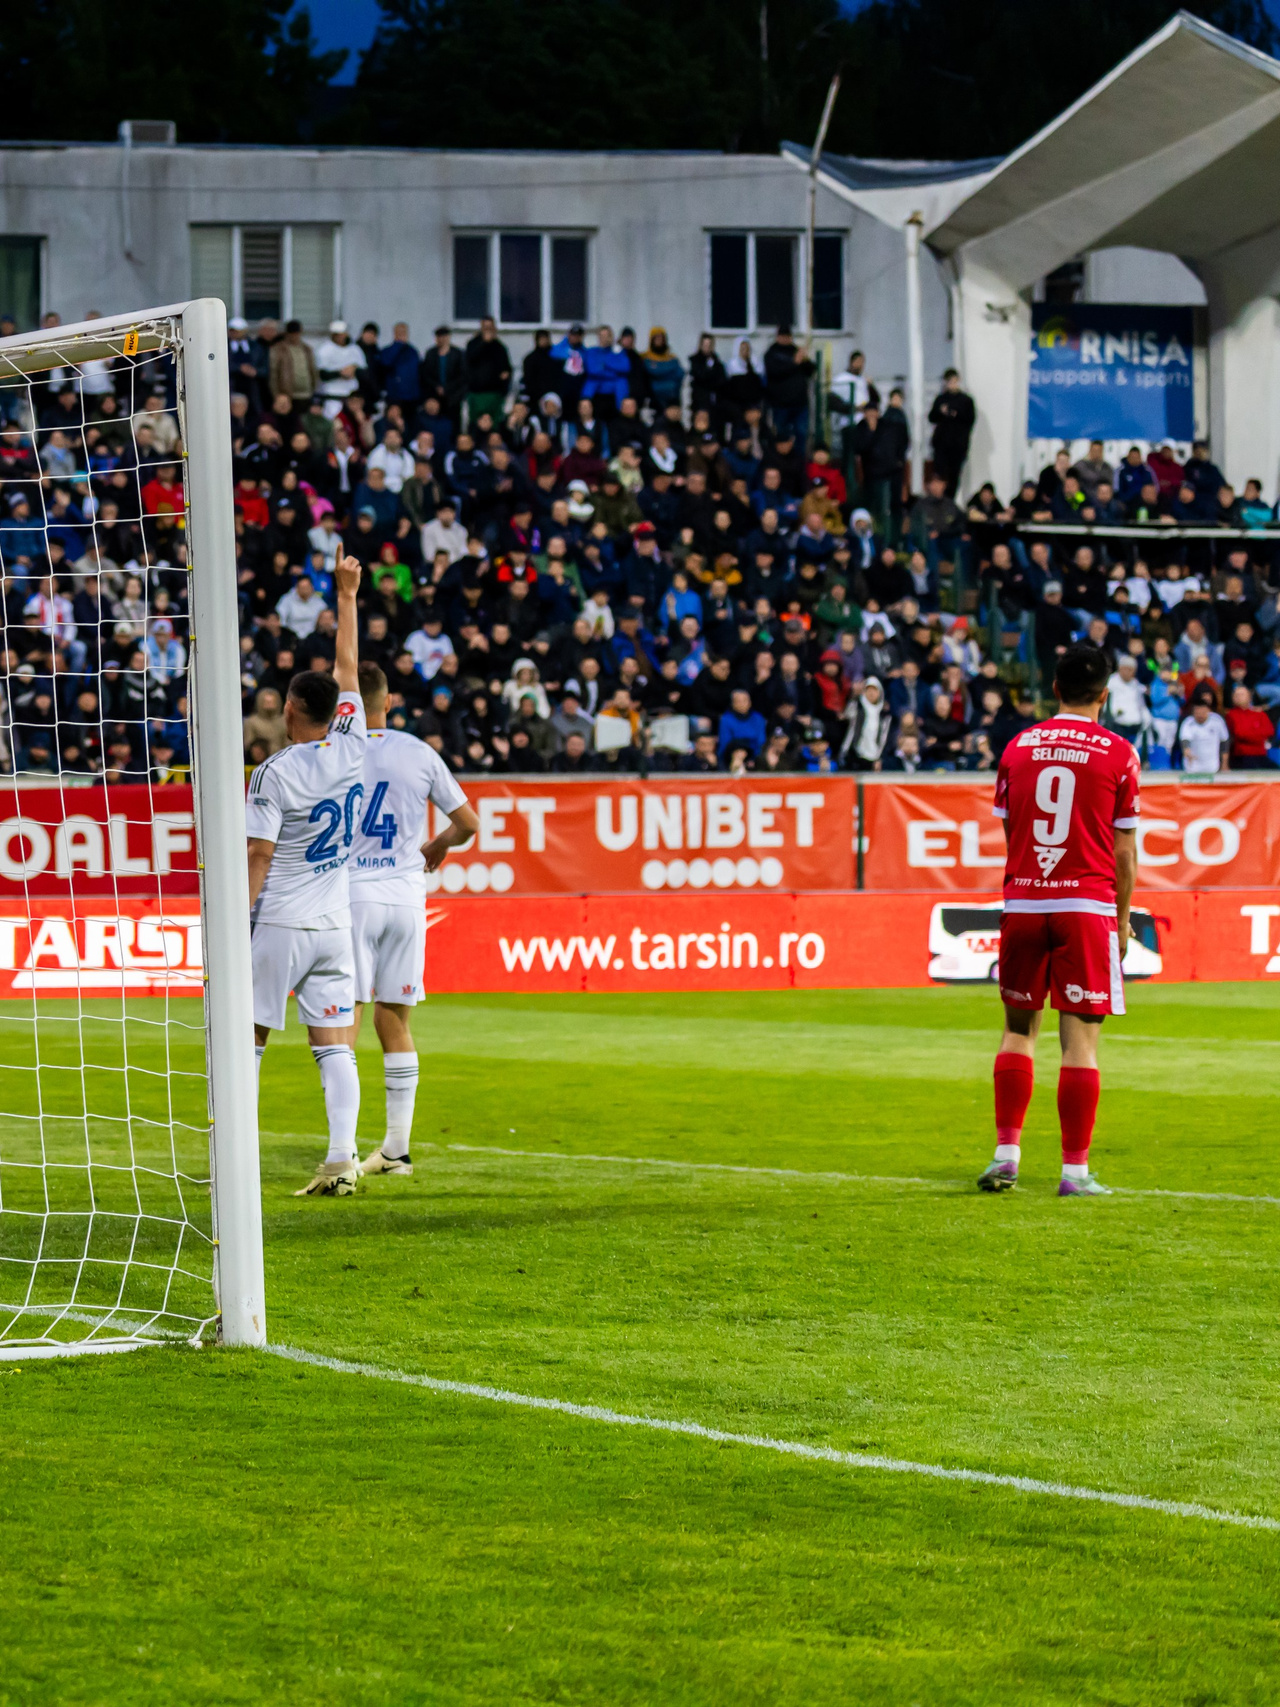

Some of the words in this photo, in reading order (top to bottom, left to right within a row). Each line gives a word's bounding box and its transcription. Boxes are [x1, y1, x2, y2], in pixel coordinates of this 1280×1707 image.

[1030, 728, 1112, 747] Regata.ro
[1032, 747, 1090, 765] SELMANI
[361, 781, 398, 849] 4
[594, 792, 825, 852] UNIBET
[1032, 765, 1076, 847] 9
[357, 856, 397, 868] MIRON
[1033, 878, 1080, 888] GAMING
[498, 921, 826, 972] www.tarsin.ro
